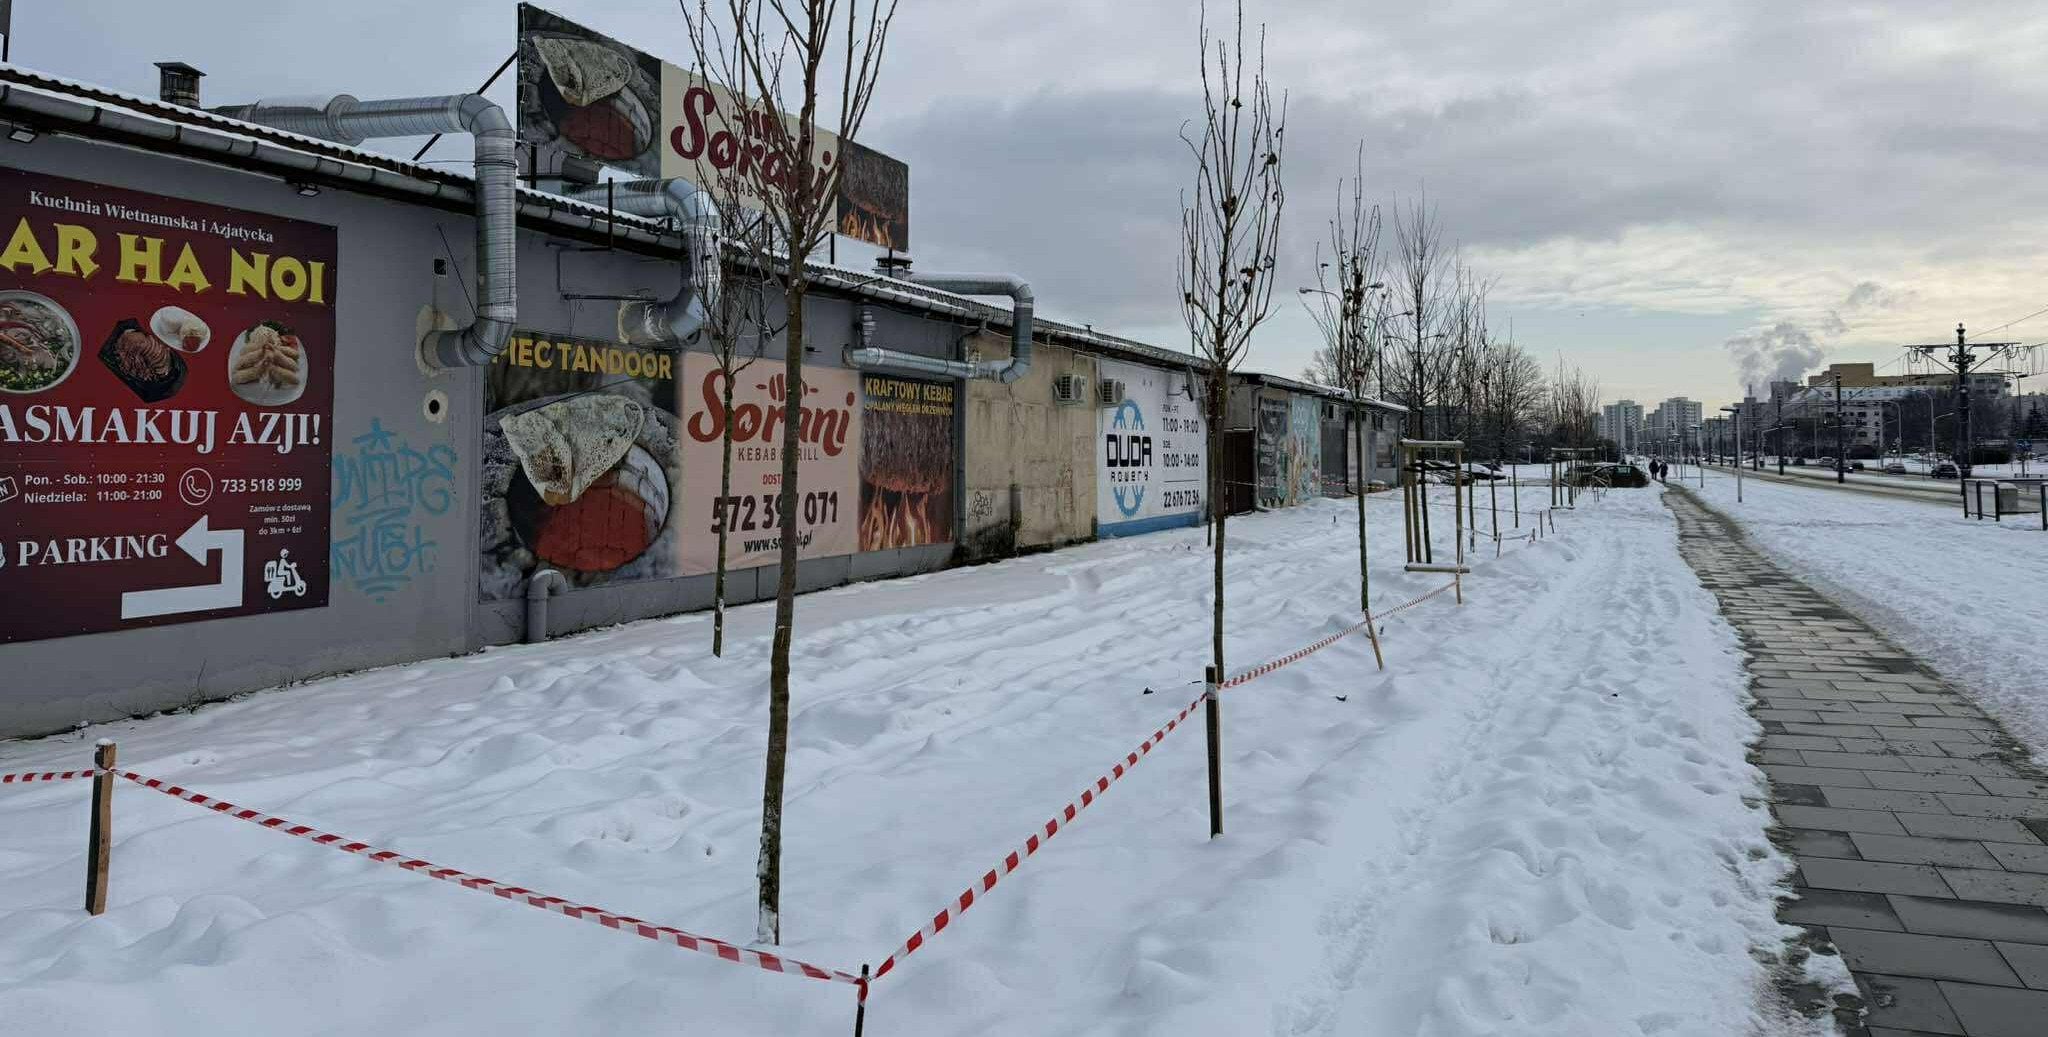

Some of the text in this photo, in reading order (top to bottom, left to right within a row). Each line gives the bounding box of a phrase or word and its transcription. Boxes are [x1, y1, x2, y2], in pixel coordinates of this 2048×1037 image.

[30, 190, 274, 243] Kuchnia Wietnamska i Azjatycka
[0, 215, 326, 305] AR HA NOI
[492, 337, 673, 380] IEC TANDOOR
[865, 377, 953, 402] KRAFTOWY KEBAB
[227, 411, 321, 454] AZJI!
[1162, 418, 1178, 432] 11:00
[738, 447, 776, 461] KEBAB
[1106, 434, 1152, 467] DUDA
[1162, 453, 1179, 467] 10:00
[25, 474, 52, 486] Pon.
[64, 473, 93, 485] Sob.:
[97, 473, 127, 484] 10:00
[136, 473, 165, 484] 21:30
[221, 478, 302, 493] 733 518 999
[24, 491, 87, 504] Niedziela:
[133, 490, 162, 501] 21:00
[1163, 491, 1171, 508] 22
[1184, 490, 1191, 506] 72
[711, 490, 838, 534] 572 39 071
[258, 527, 268, 535] do
[744, 529, 813, 553] www.soi.pl
[17, 533, 168, 567] PARKING
